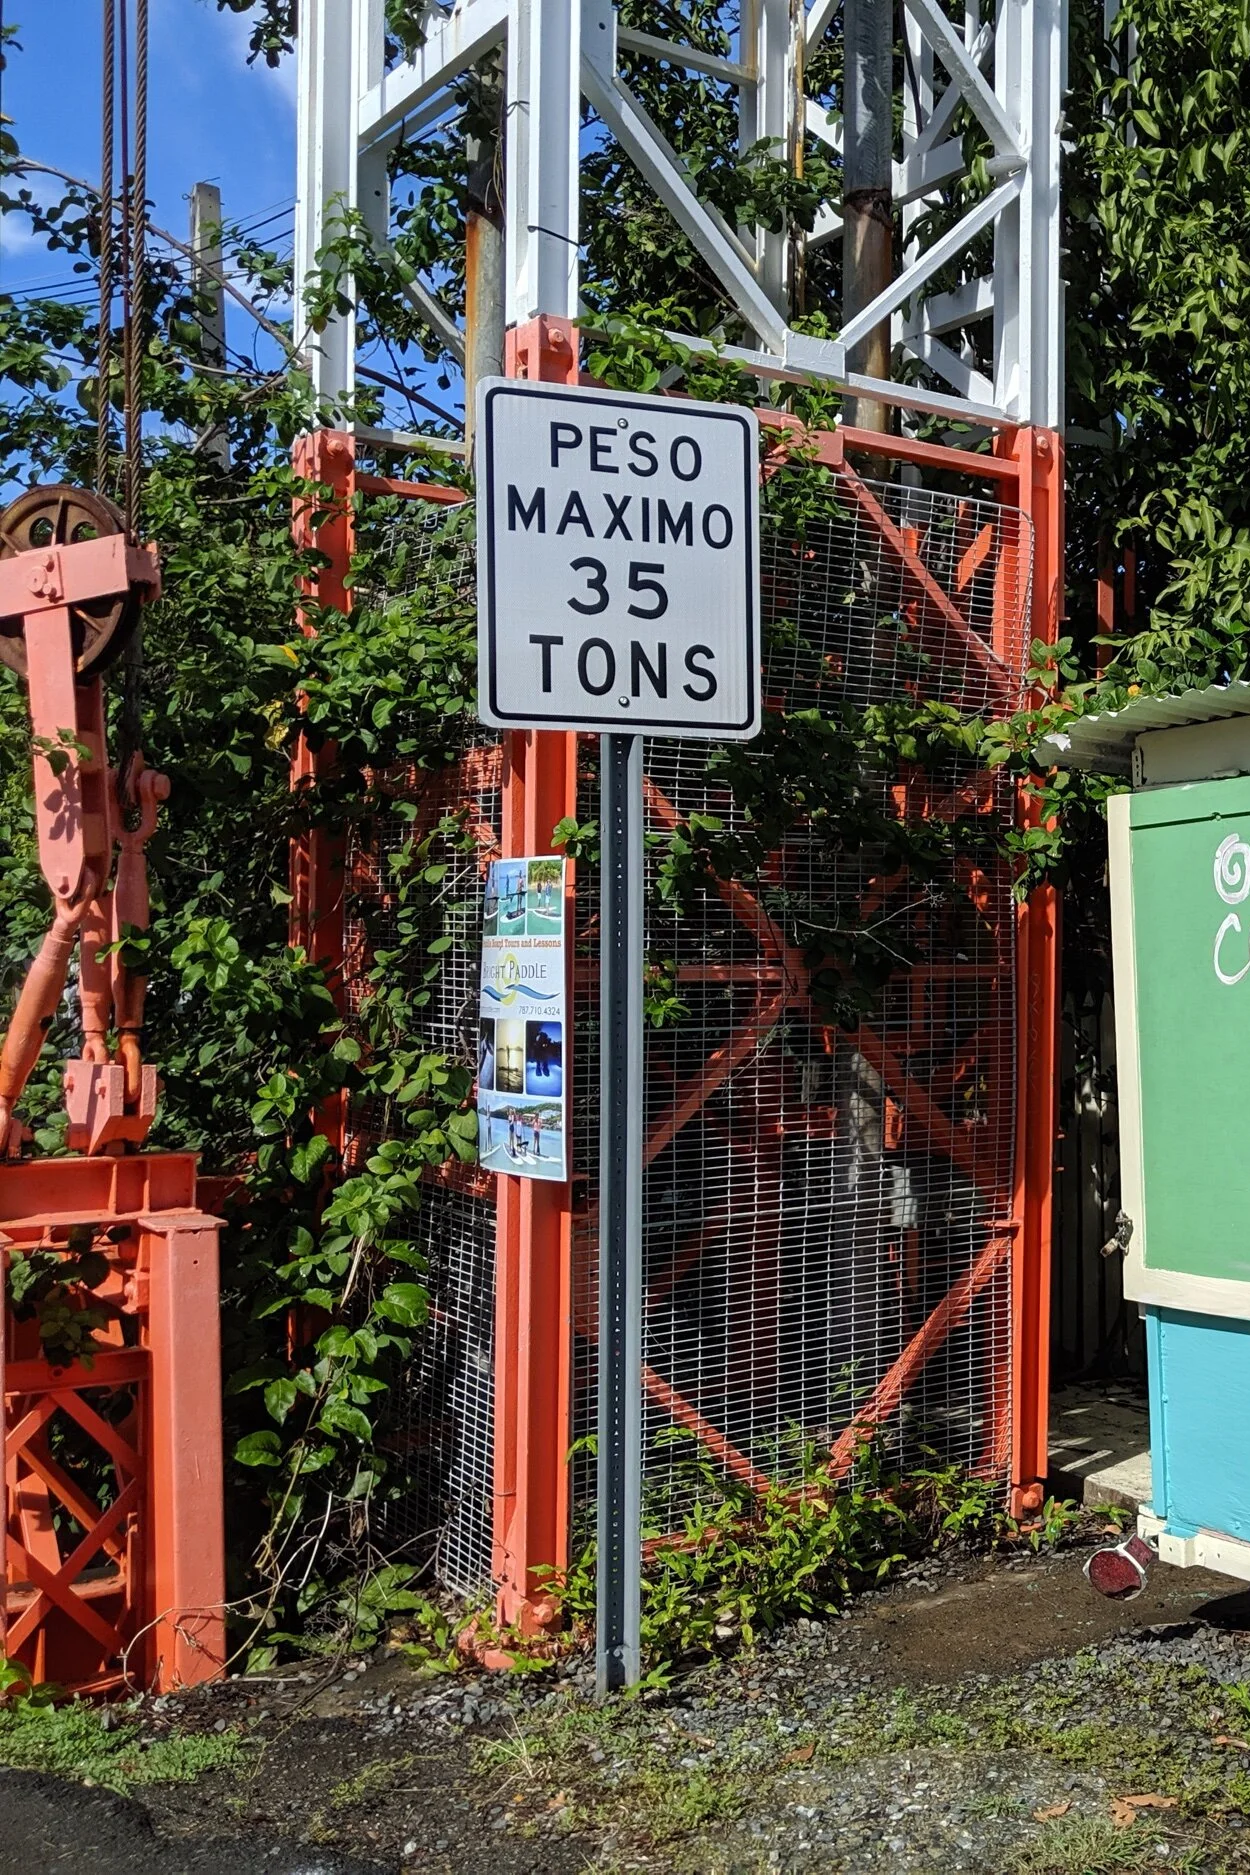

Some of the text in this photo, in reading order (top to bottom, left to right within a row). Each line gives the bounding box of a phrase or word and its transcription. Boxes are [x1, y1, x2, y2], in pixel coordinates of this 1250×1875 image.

[550, 421, 702, 482] PESO
[507, 484, 734, 550] MAXIMO
[567, 556, 669, 620] 35
[529, 633, 718, 702] TONS
[504, 938, 520, 948] Tours
[521, 938, 532, 948] and
[534, 938, 562, 948] Lessons
[509, 960, 547, 980] PADDLE
[519, 1005, 560, 1016] 787.710.4324
